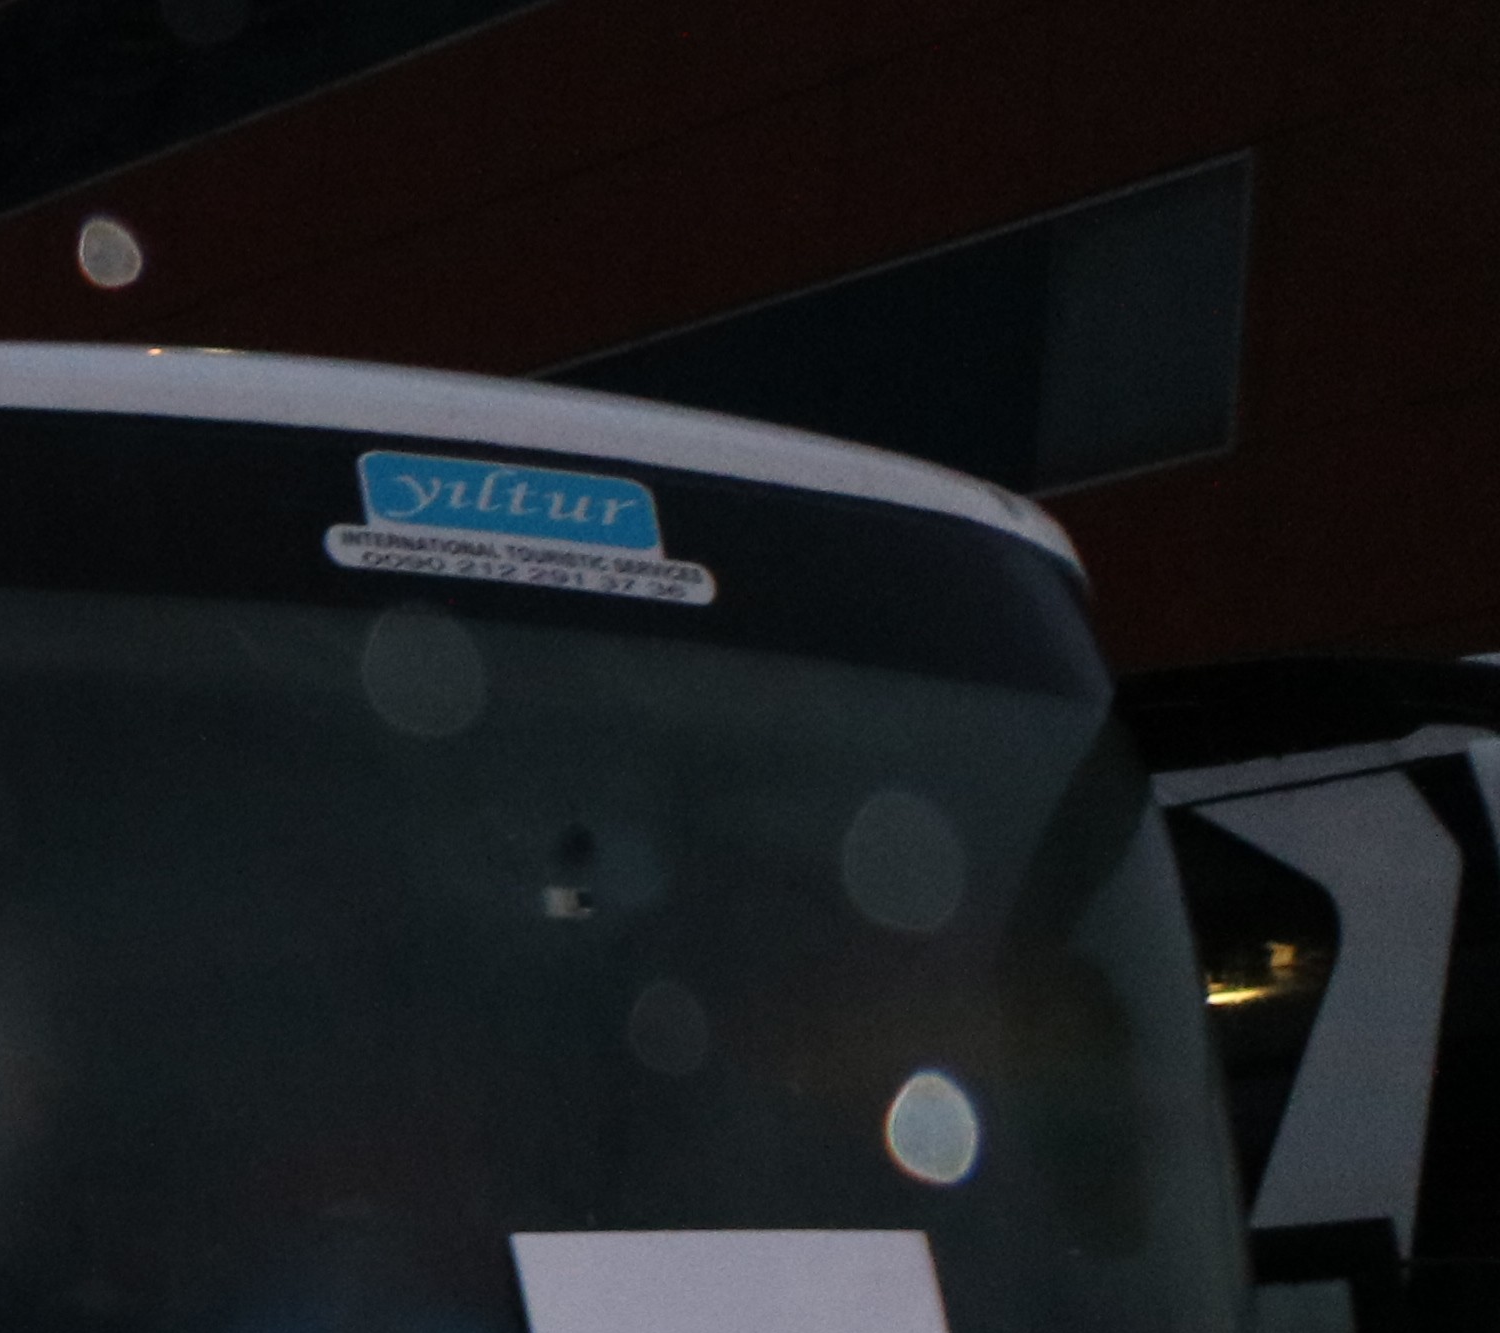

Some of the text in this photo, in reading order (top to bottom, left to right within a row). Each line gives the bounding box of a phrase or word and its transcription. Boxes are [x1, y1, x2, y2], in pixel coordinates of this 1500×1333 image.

[341, 531, 702, 585] INTERNATIONAL TOURISTIC SERVICES
